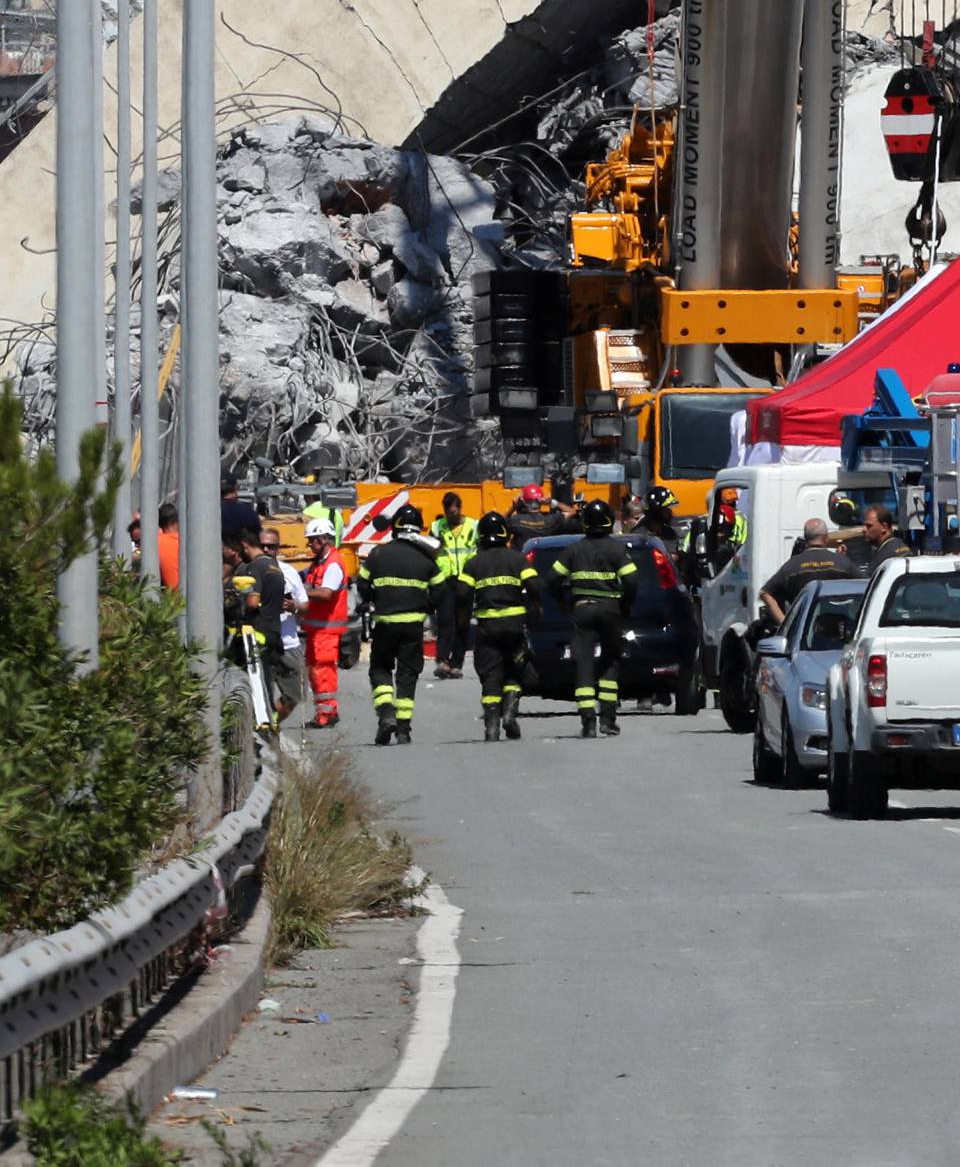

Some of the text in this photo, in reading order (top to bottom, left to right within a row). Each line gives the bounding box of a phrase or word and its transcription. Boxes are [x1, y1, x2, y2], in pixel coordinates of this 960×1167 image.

[686, 23, 702, 66] 900
[684, 75, 701, 186] MOMENT
[682, 194, 698, 263] LOAD
